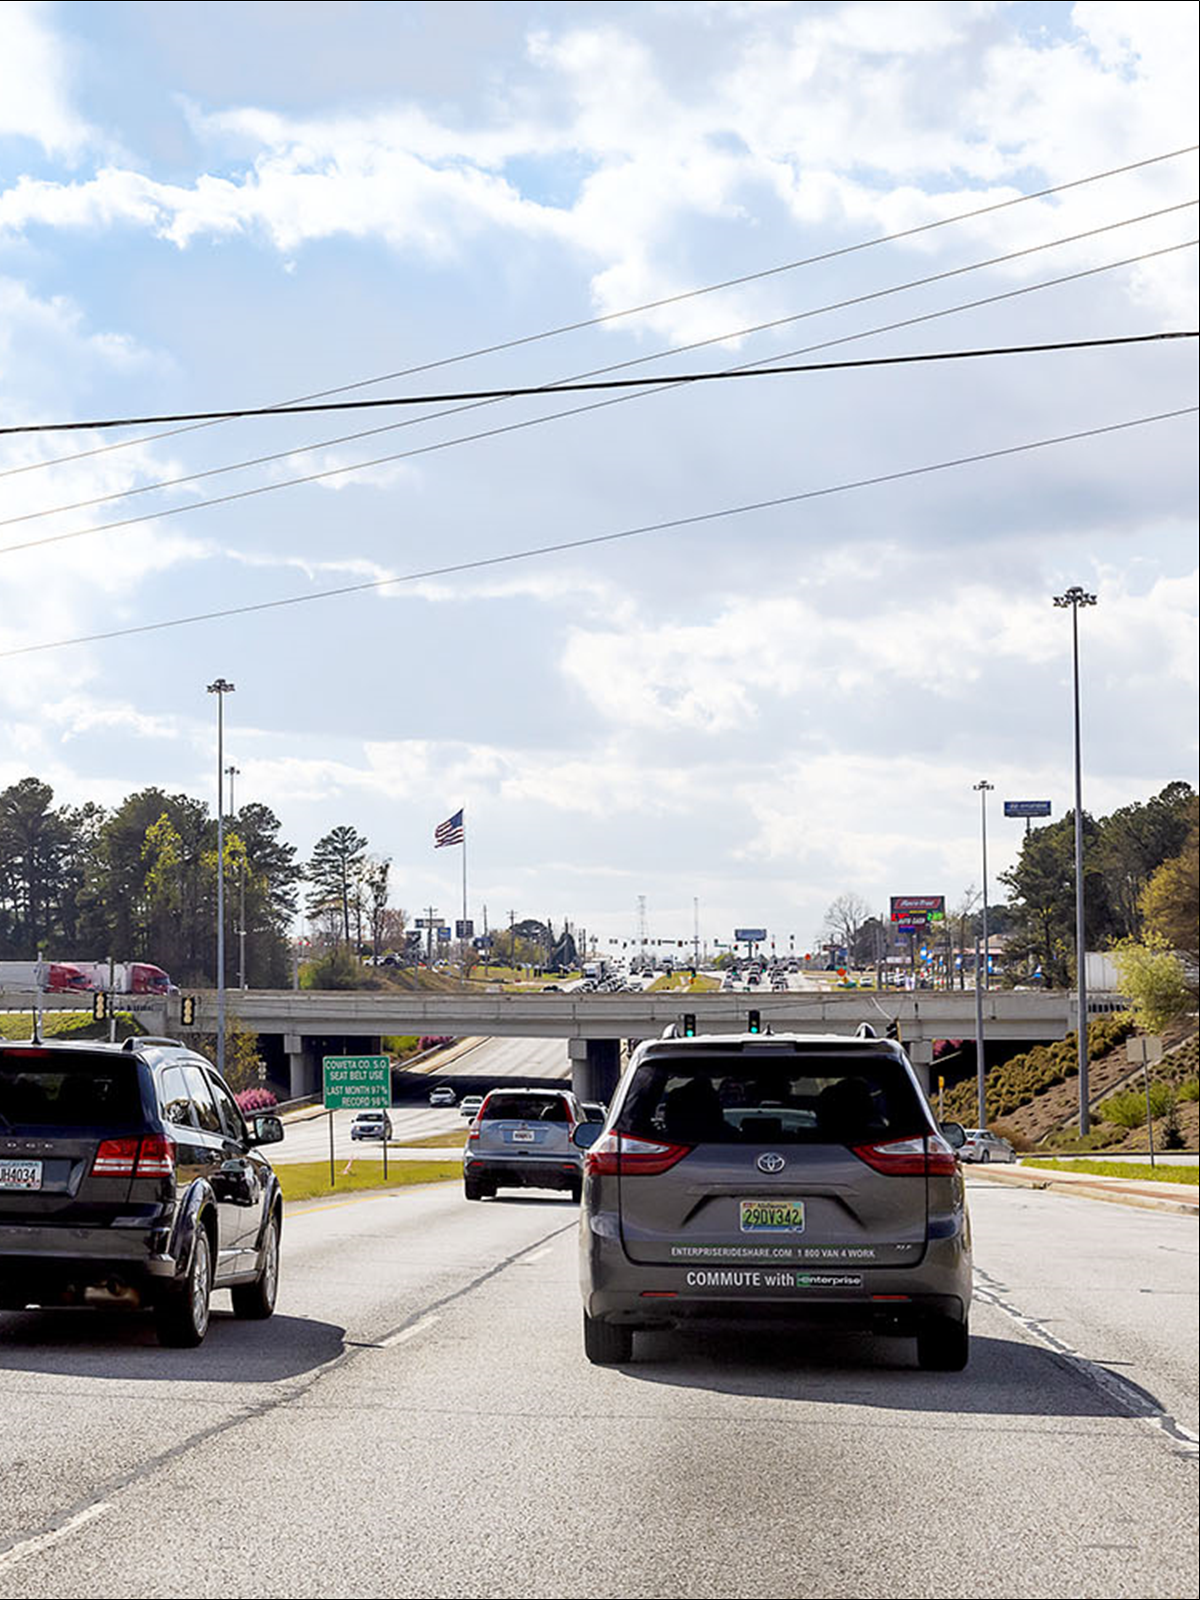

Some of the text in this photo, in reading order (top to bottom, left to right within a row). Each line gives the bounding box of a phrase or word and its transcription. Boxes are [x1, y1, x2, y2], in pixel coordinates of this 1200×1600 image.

[326, 1060, 357, 1069] COWETA
[330, 1071, 384, 1080] SEAT BELT USE
[326, 1086, 343, 1095] LAST
[345, 1086, 370, 1095] MONTH
[342, 1097, 369, 1106] RECORD
[744, 1208, 799, 1225] 29DV342
[671, 1247, 793, 1257] ENTERPRISERIDESHARE.COM
[804, 1248, 820, 1257] 800
[821, 1248, 839, 1257] VAN
[841, 1248, 847, 1257] 4
[848, 1248, 875, 1258] WORK
[686, 1271, 862, 1286] COMMUTE with enterprise
